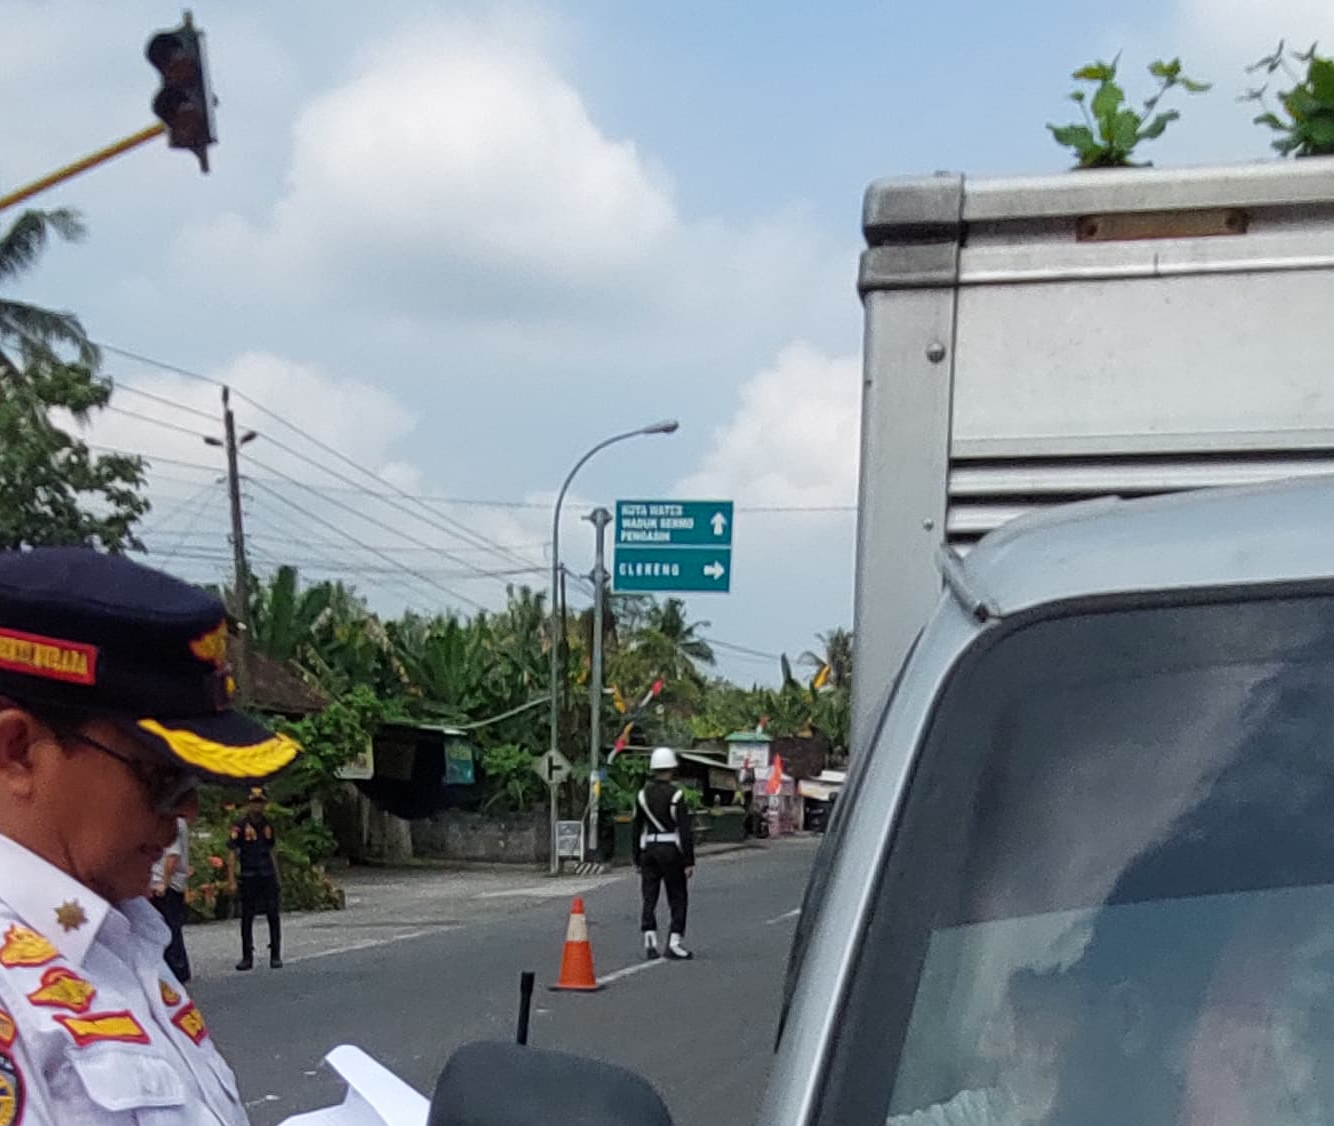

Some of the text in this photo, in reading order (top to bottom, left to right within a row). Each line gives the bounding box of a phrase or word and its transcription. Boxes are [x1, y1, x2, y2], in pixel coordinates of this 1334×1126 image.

[621, 505, 683, 516] KOTA WATES
[622, 517, 657, 529] WADUK
